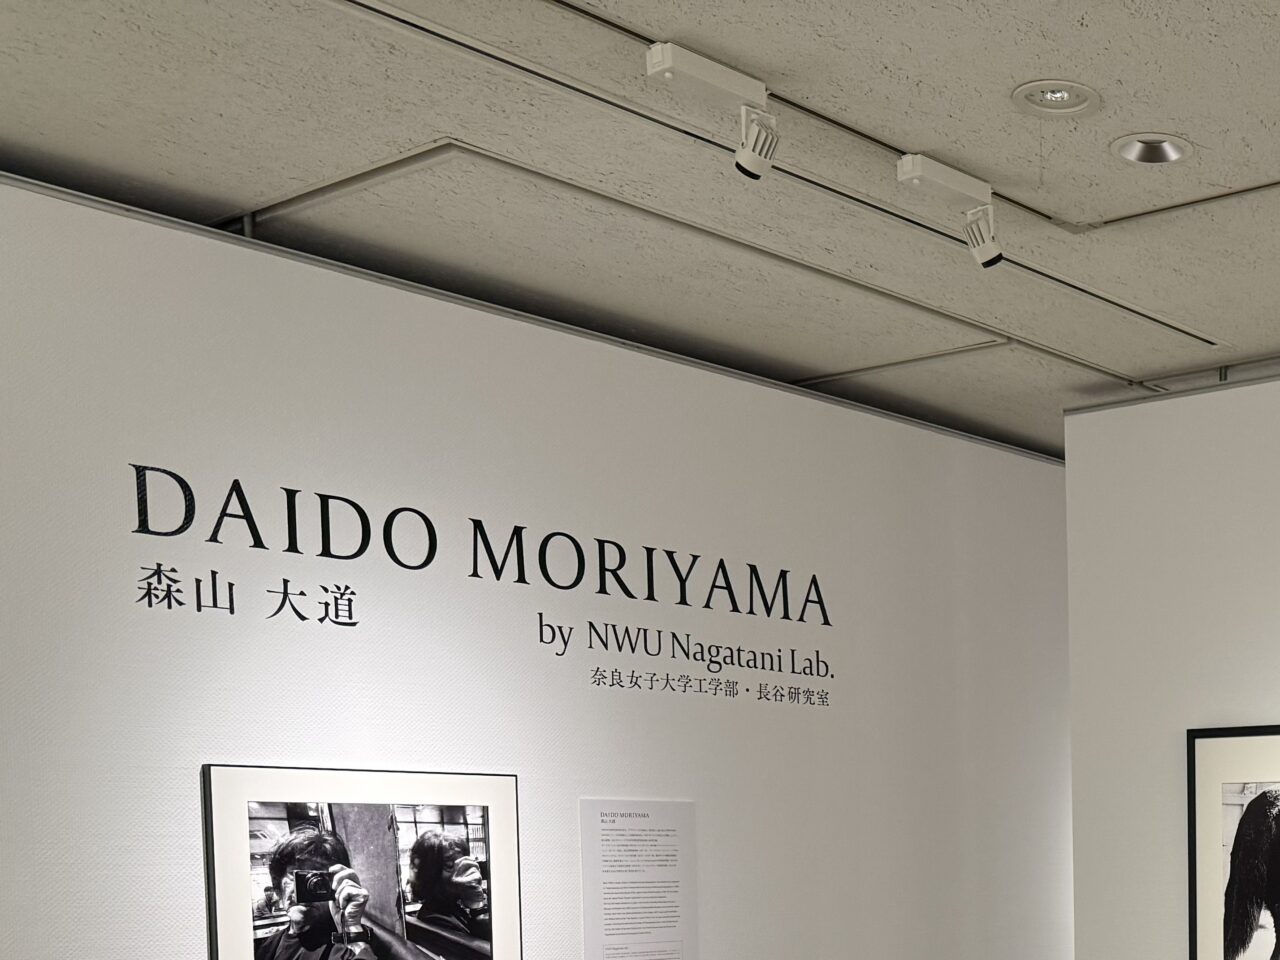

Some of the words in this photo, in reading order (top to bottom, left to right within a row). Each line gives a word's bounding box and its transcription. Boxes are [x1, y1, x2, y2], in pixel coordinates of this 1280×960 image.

[127, 462, 438, 571] DAIDO
[467, 518, 833, 627] MORIYAMA
[135, 562, 236, 616] 森山
[266, 578, 361, 628] 大道
[536, 612, 576, 657] by
[586, 620, 664, 658] NWU
[669, 631, 785, 674] Nagatani
[789, 648, 837, 680] Lab.
[590, 665, 831, 708] 奈良女子大学工学部・長谷研究室
